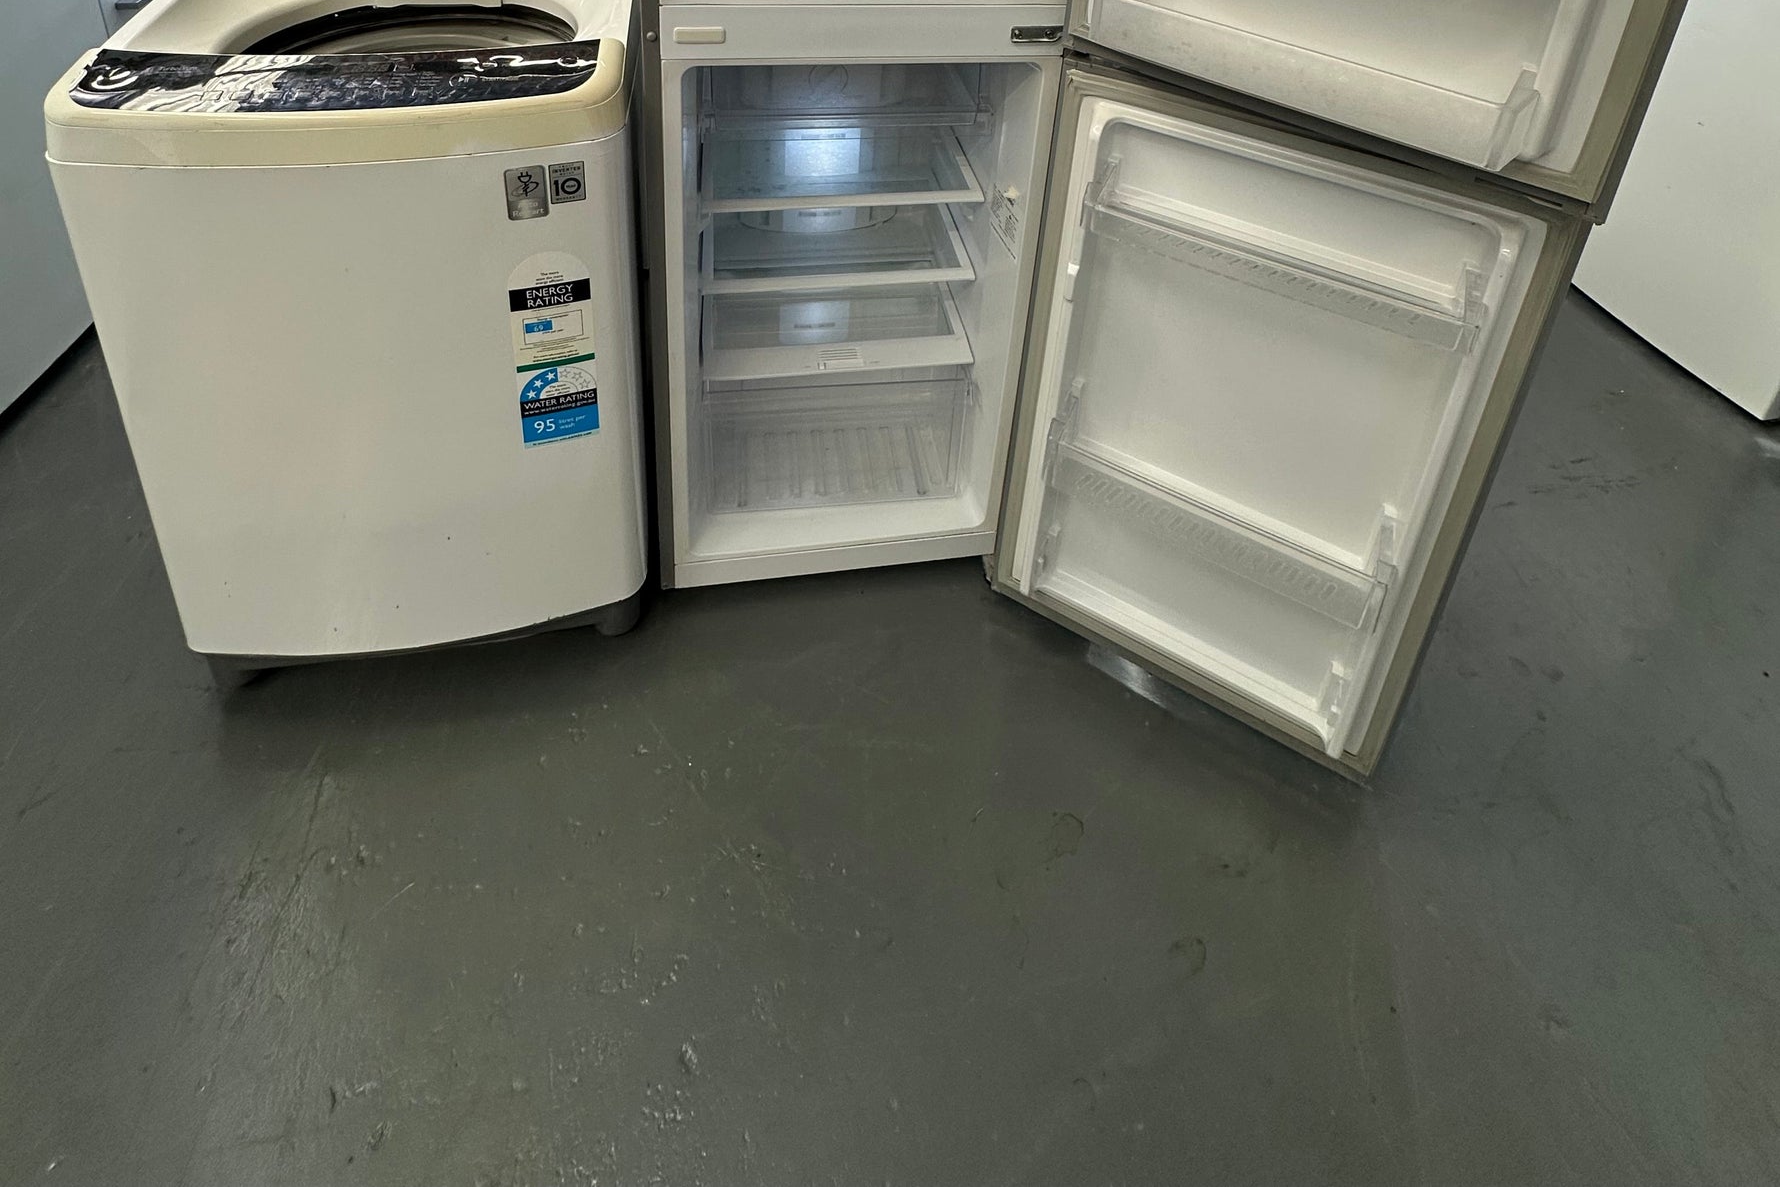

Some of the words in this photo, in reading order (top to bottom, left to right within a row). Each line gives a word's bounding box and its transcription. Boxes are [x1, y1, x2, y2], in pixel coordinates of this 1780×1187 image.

[553, 177, 582, 197] 10
[526, 284, 574, 299] ENERGY
[527, 293, 574, 308] RATING
[524, 398, 557, 410] WATER
[559, 391, 595, 403] RATING
[534, 418, 556, 434] 95
